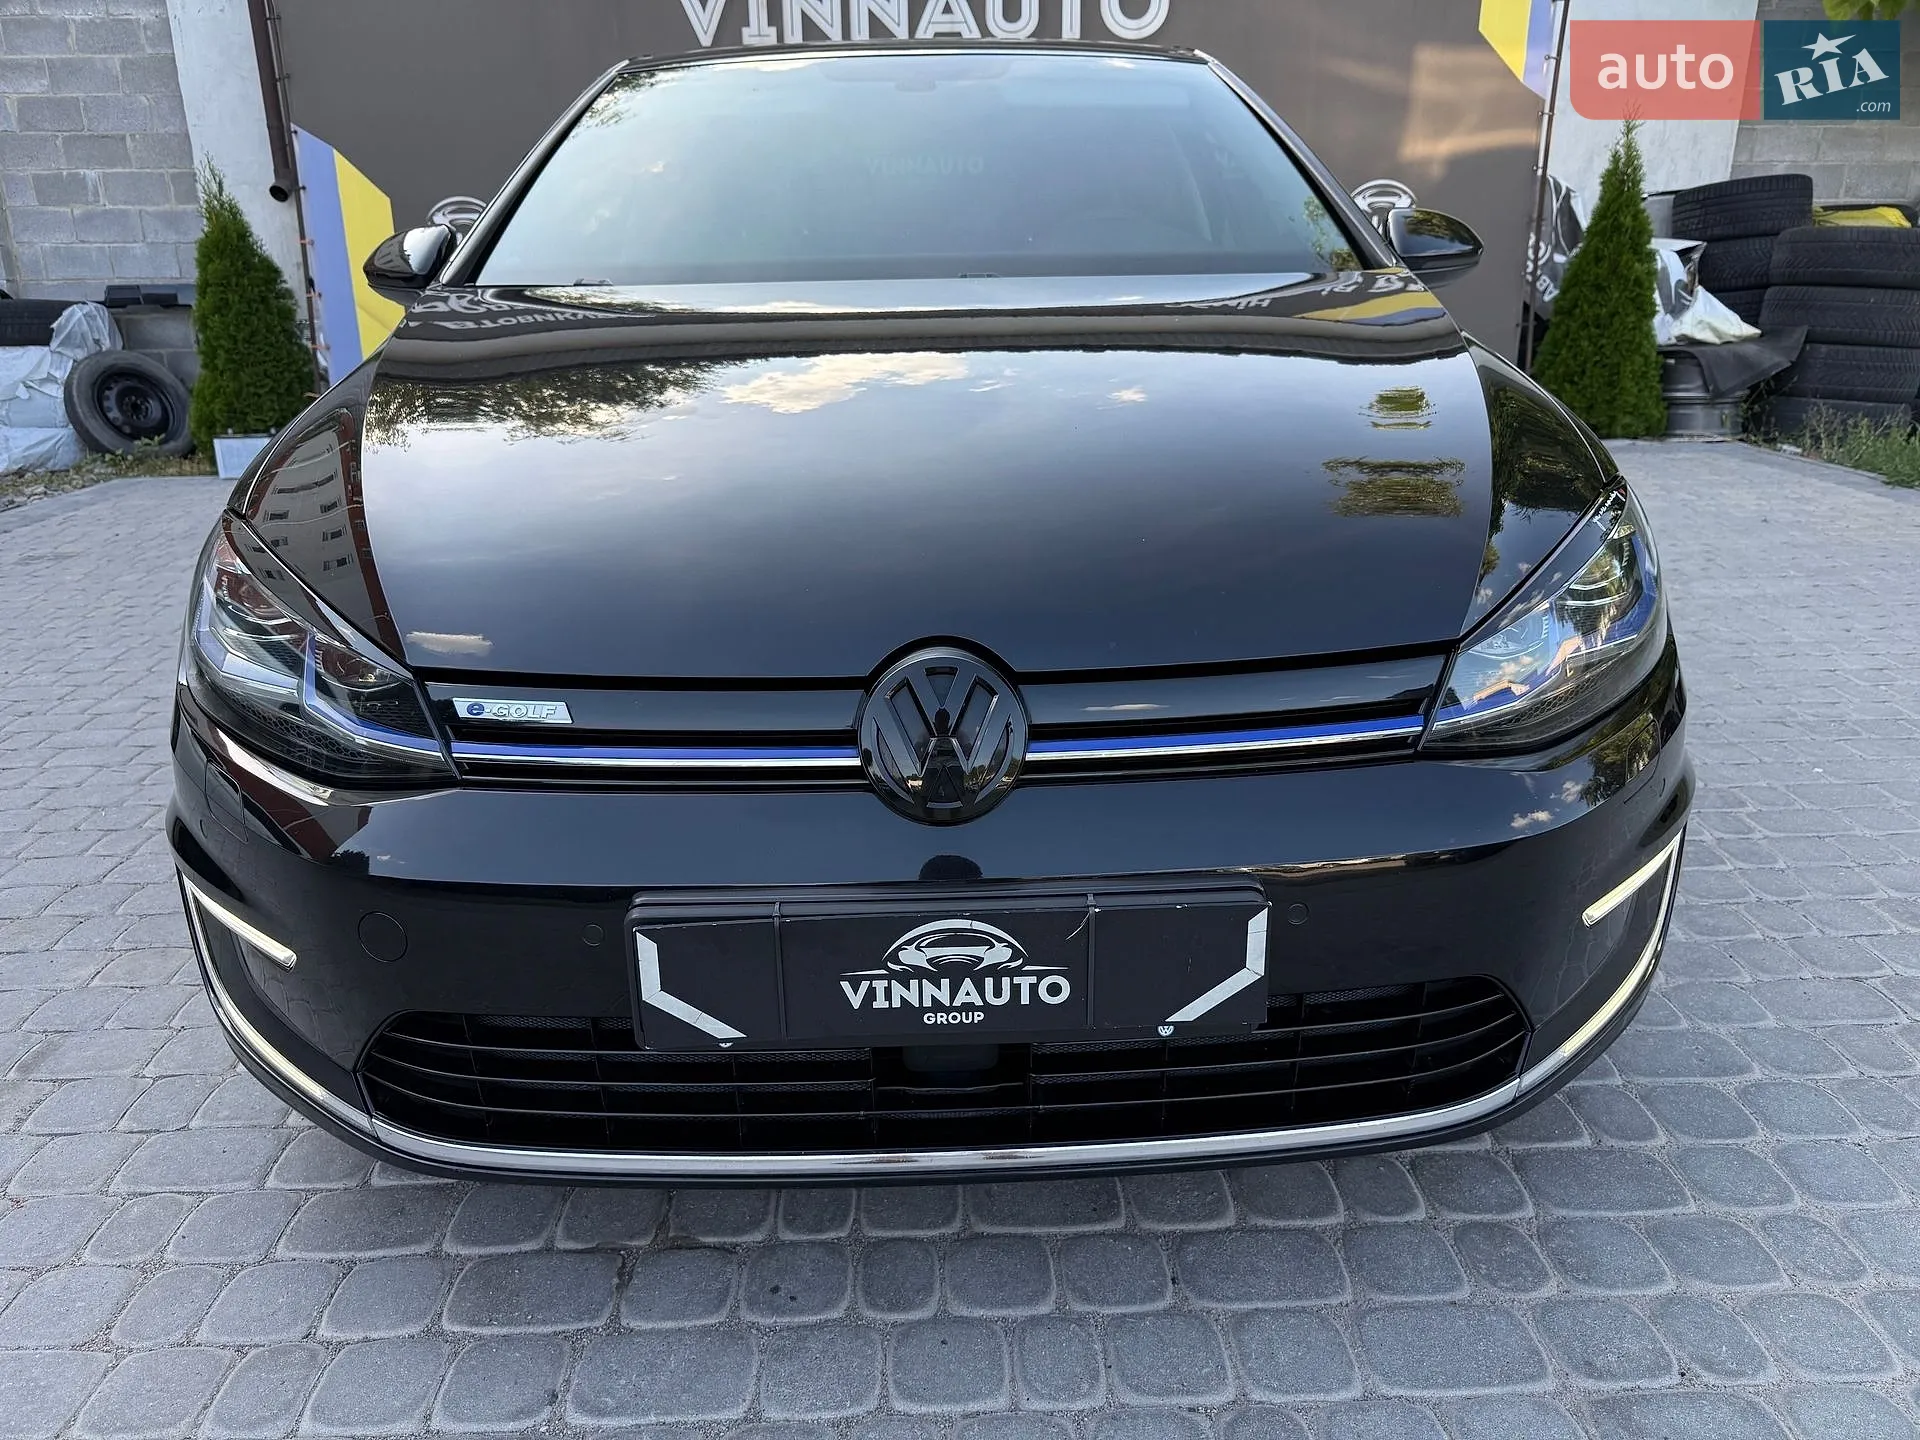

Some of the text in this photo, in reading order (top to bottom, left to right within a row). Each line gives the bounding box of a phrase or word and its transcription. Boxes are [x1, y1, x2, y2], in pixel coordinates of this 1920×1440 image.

[466, 702, 558, 719] e-GOLF
[840, 975, 1071, 1010] VINNAUTO
[923, 1011, 985, 1025] GROUP
